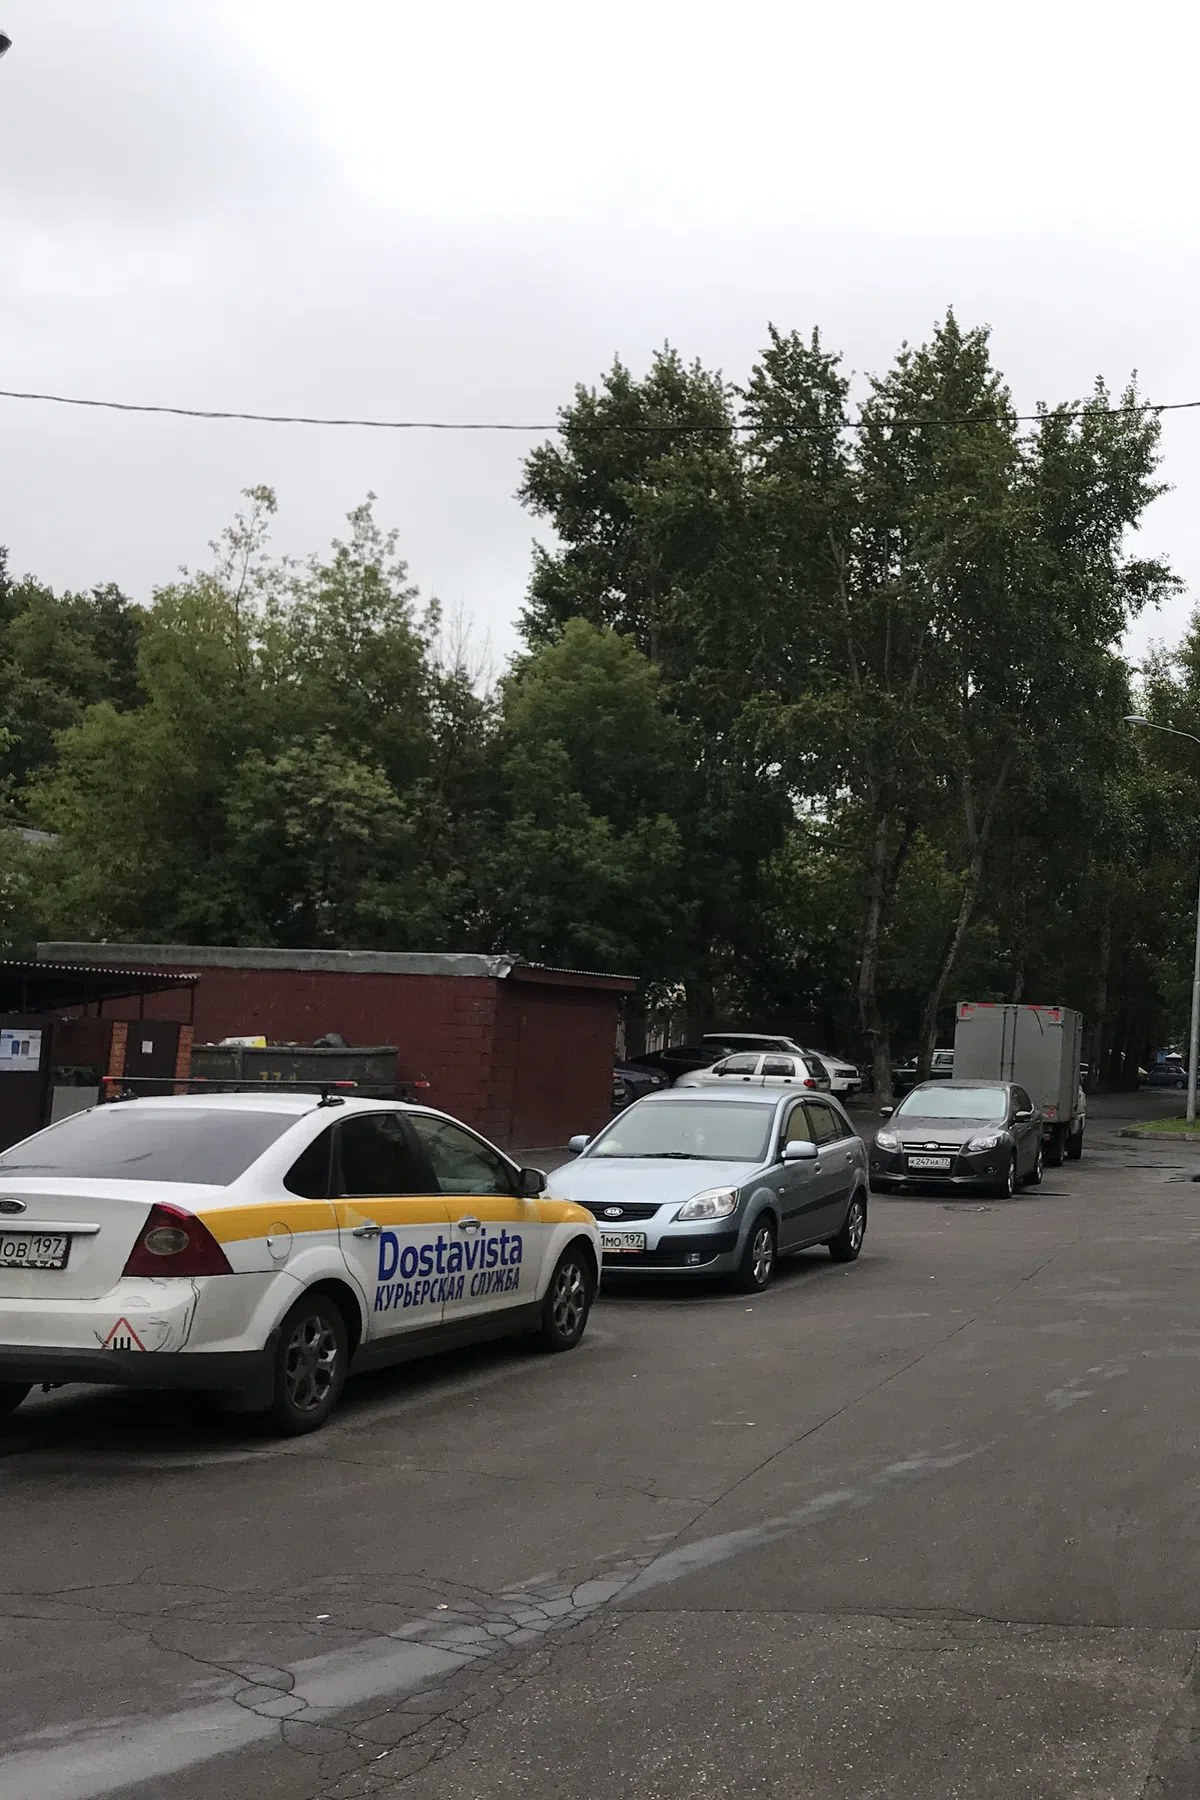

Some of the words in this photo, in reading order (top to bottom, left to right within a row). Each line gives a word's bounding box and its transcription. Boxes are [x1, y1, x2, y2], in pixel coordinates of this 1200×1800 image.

[34, 1237, 62, 1253] 197
[378, 1228, 522, 1281] Dostavista
[624, 1235, 640, 1244] 197
[374, 1274, 465, 1311] КУРЬЕРСКАЯ
[470, 1267, 520, 1297] СЛУЖБА
